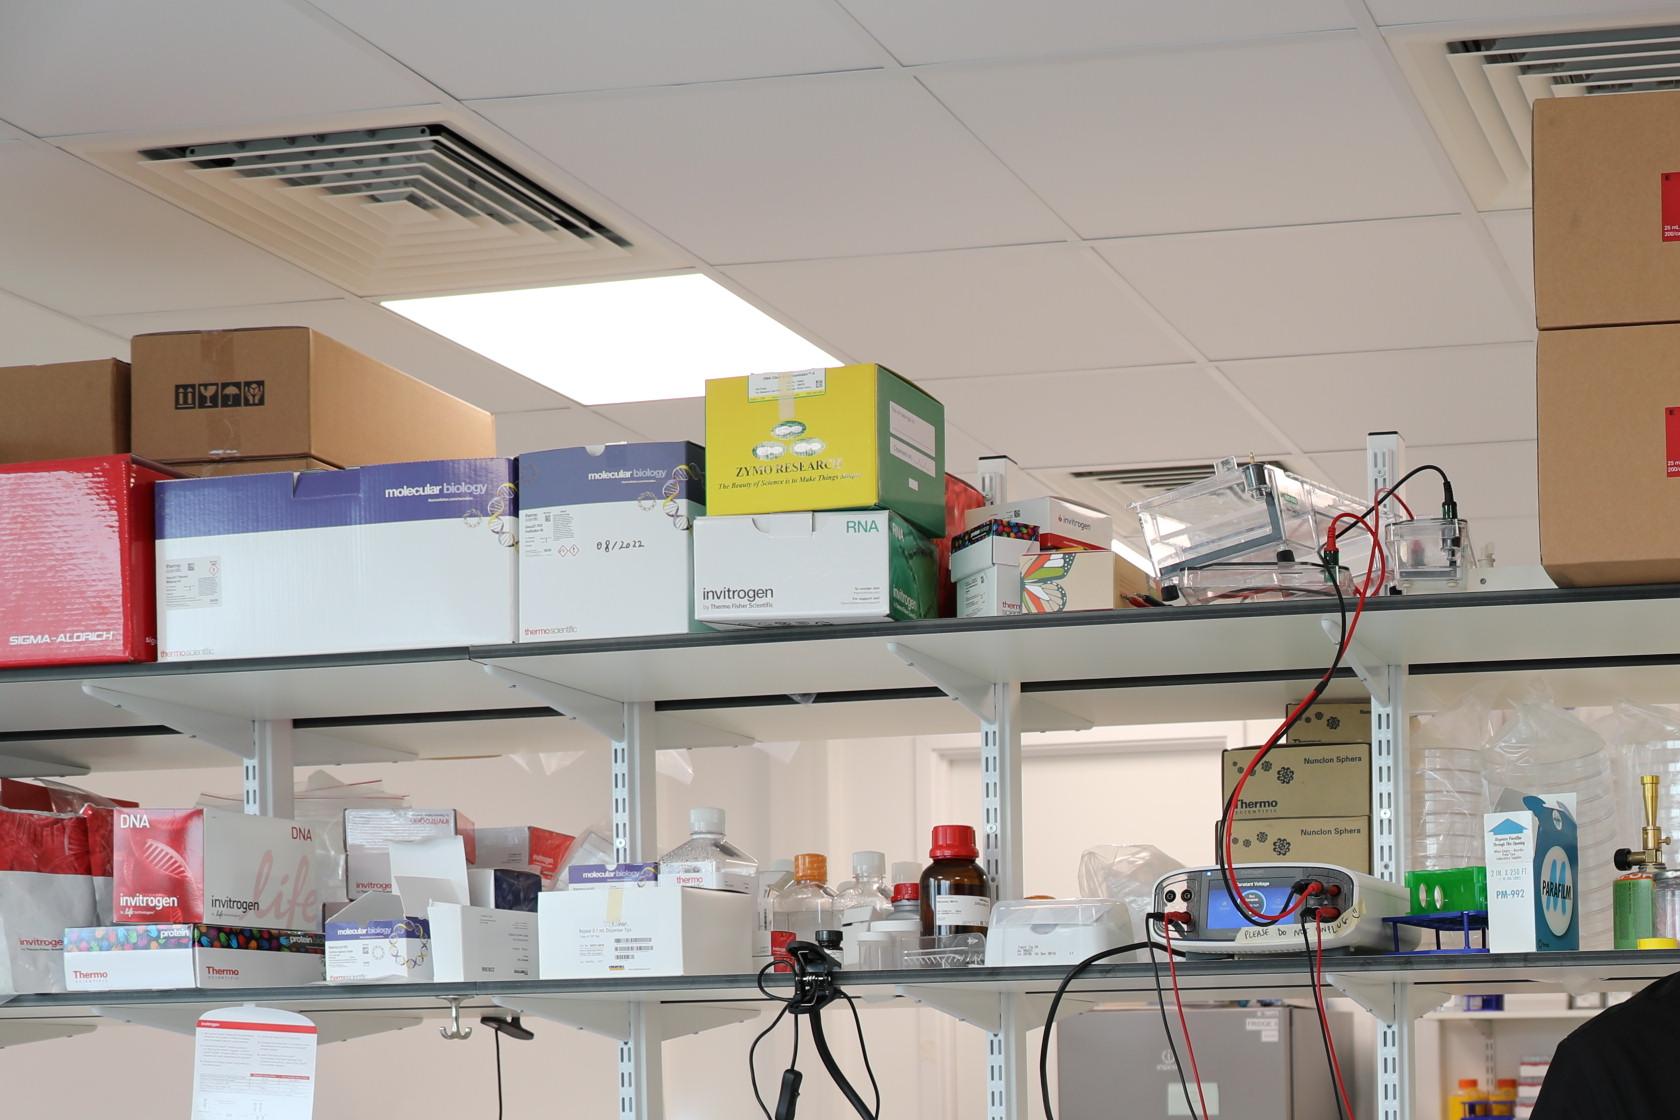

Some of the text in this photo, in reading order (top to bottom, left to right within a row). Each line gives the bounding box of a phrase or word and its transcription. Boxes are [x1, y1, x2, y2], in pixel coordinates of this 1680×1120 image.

[588, 468, 668, 480] molecular biology
[736, 464, 773, 477] ZYMO
[761, 478, 784, 487] Science
[799, 474, 817, 484] Make
[385, 482, 488, 498] molecular biology
[846, 520, 880, 534] RNA
[596, 540, 645, 552] 08/2022
[702, 586, 774, 602] invitrogen
[711, 602, 731, 610] Thermo
[1002, 601, 1022, 609] therm
[9, 631, 114, 646] SIGMA-ALDRICH
[1303, 755, 1362, 765] Nunclon Sphera
[120, 814, 150, 829] DNA
[291, 826, 313, 842] DNA
[1301, 827, 1361, 837] Nunclon Sphera
[582, 870, 616, 879] molecular
[676, 875, 705, 884] thermo
[355, 881, 392, 891] invitroge
[1542, 880, 1572, 900] PARAFILM
[1496, 889, 1526, 900] PM-992
[119, 893, 178, 910] invitrogen
[211, 896, 260, 914] invitrogen
[160, 928, 190, 939] protein
[337, 927, 368, 936] molecular
[1244, 928, 1270, 940] PLEASE
[19, 937, 64, 947] invitroge
[289, 935, 313, 944] protein
[73, 971, 108, 979] Thermo
[206, 966, 239, 975] Thermo
